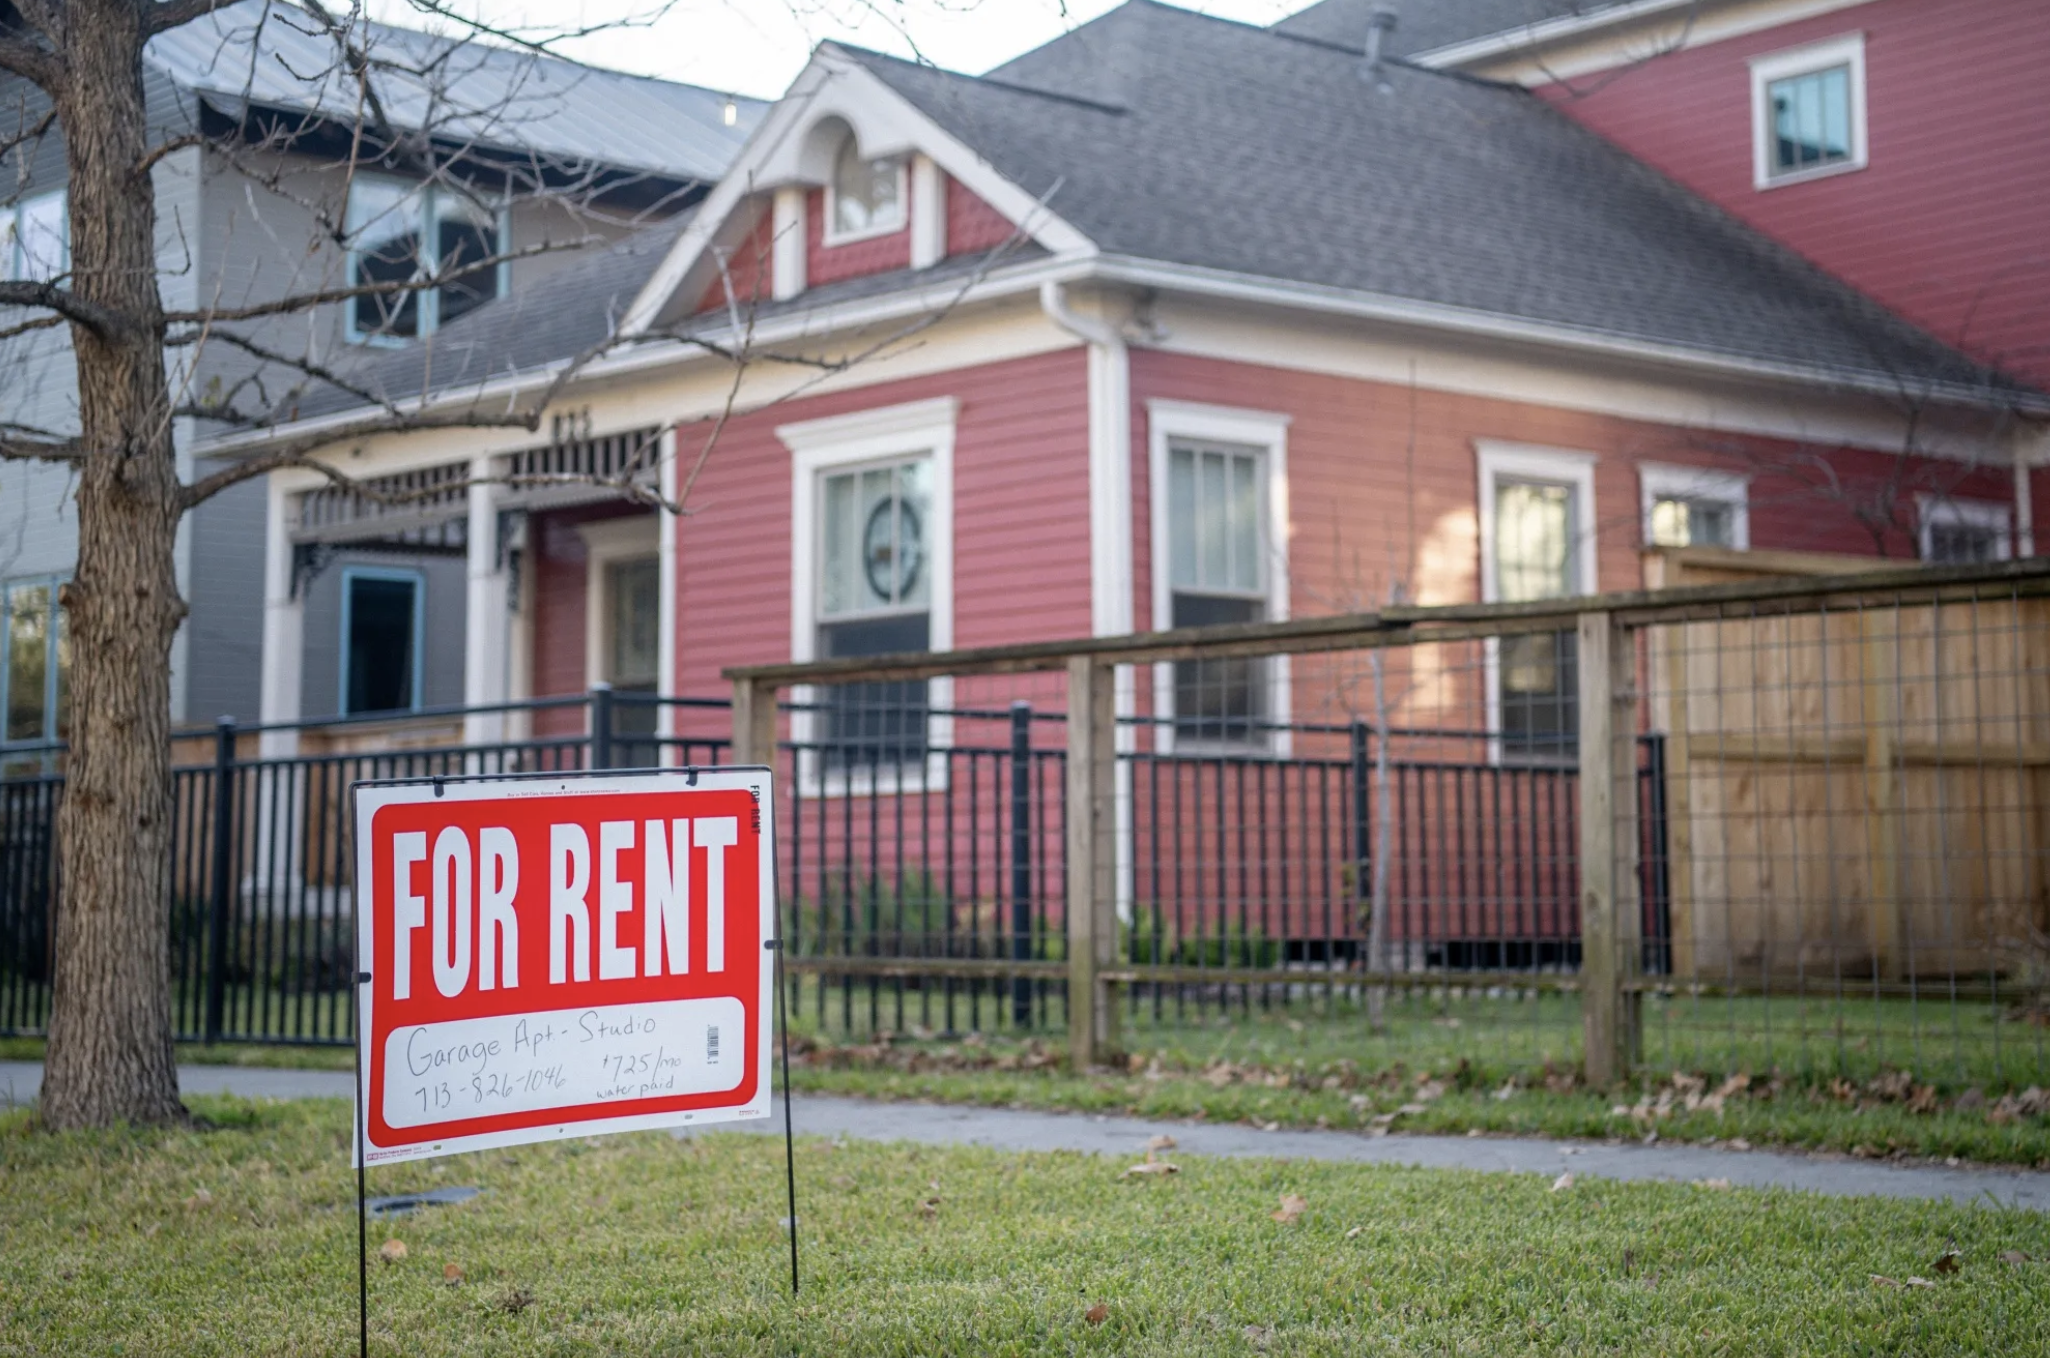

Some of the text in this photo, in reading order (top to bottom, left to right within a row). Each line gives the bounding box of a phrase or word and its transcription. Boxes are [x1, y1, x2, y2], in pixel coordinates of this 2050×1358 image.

[751, 785, 761, 834] FOR RENT
[393, 816, 738, 1000] FOR RENT
[407, 1027, 501, 1076] Garage
[579, 1010, 656, 1042] Studio
[415, 1064, 567, 1112] 713-826-1046
[596, 1075, 674, 1099] water paid
